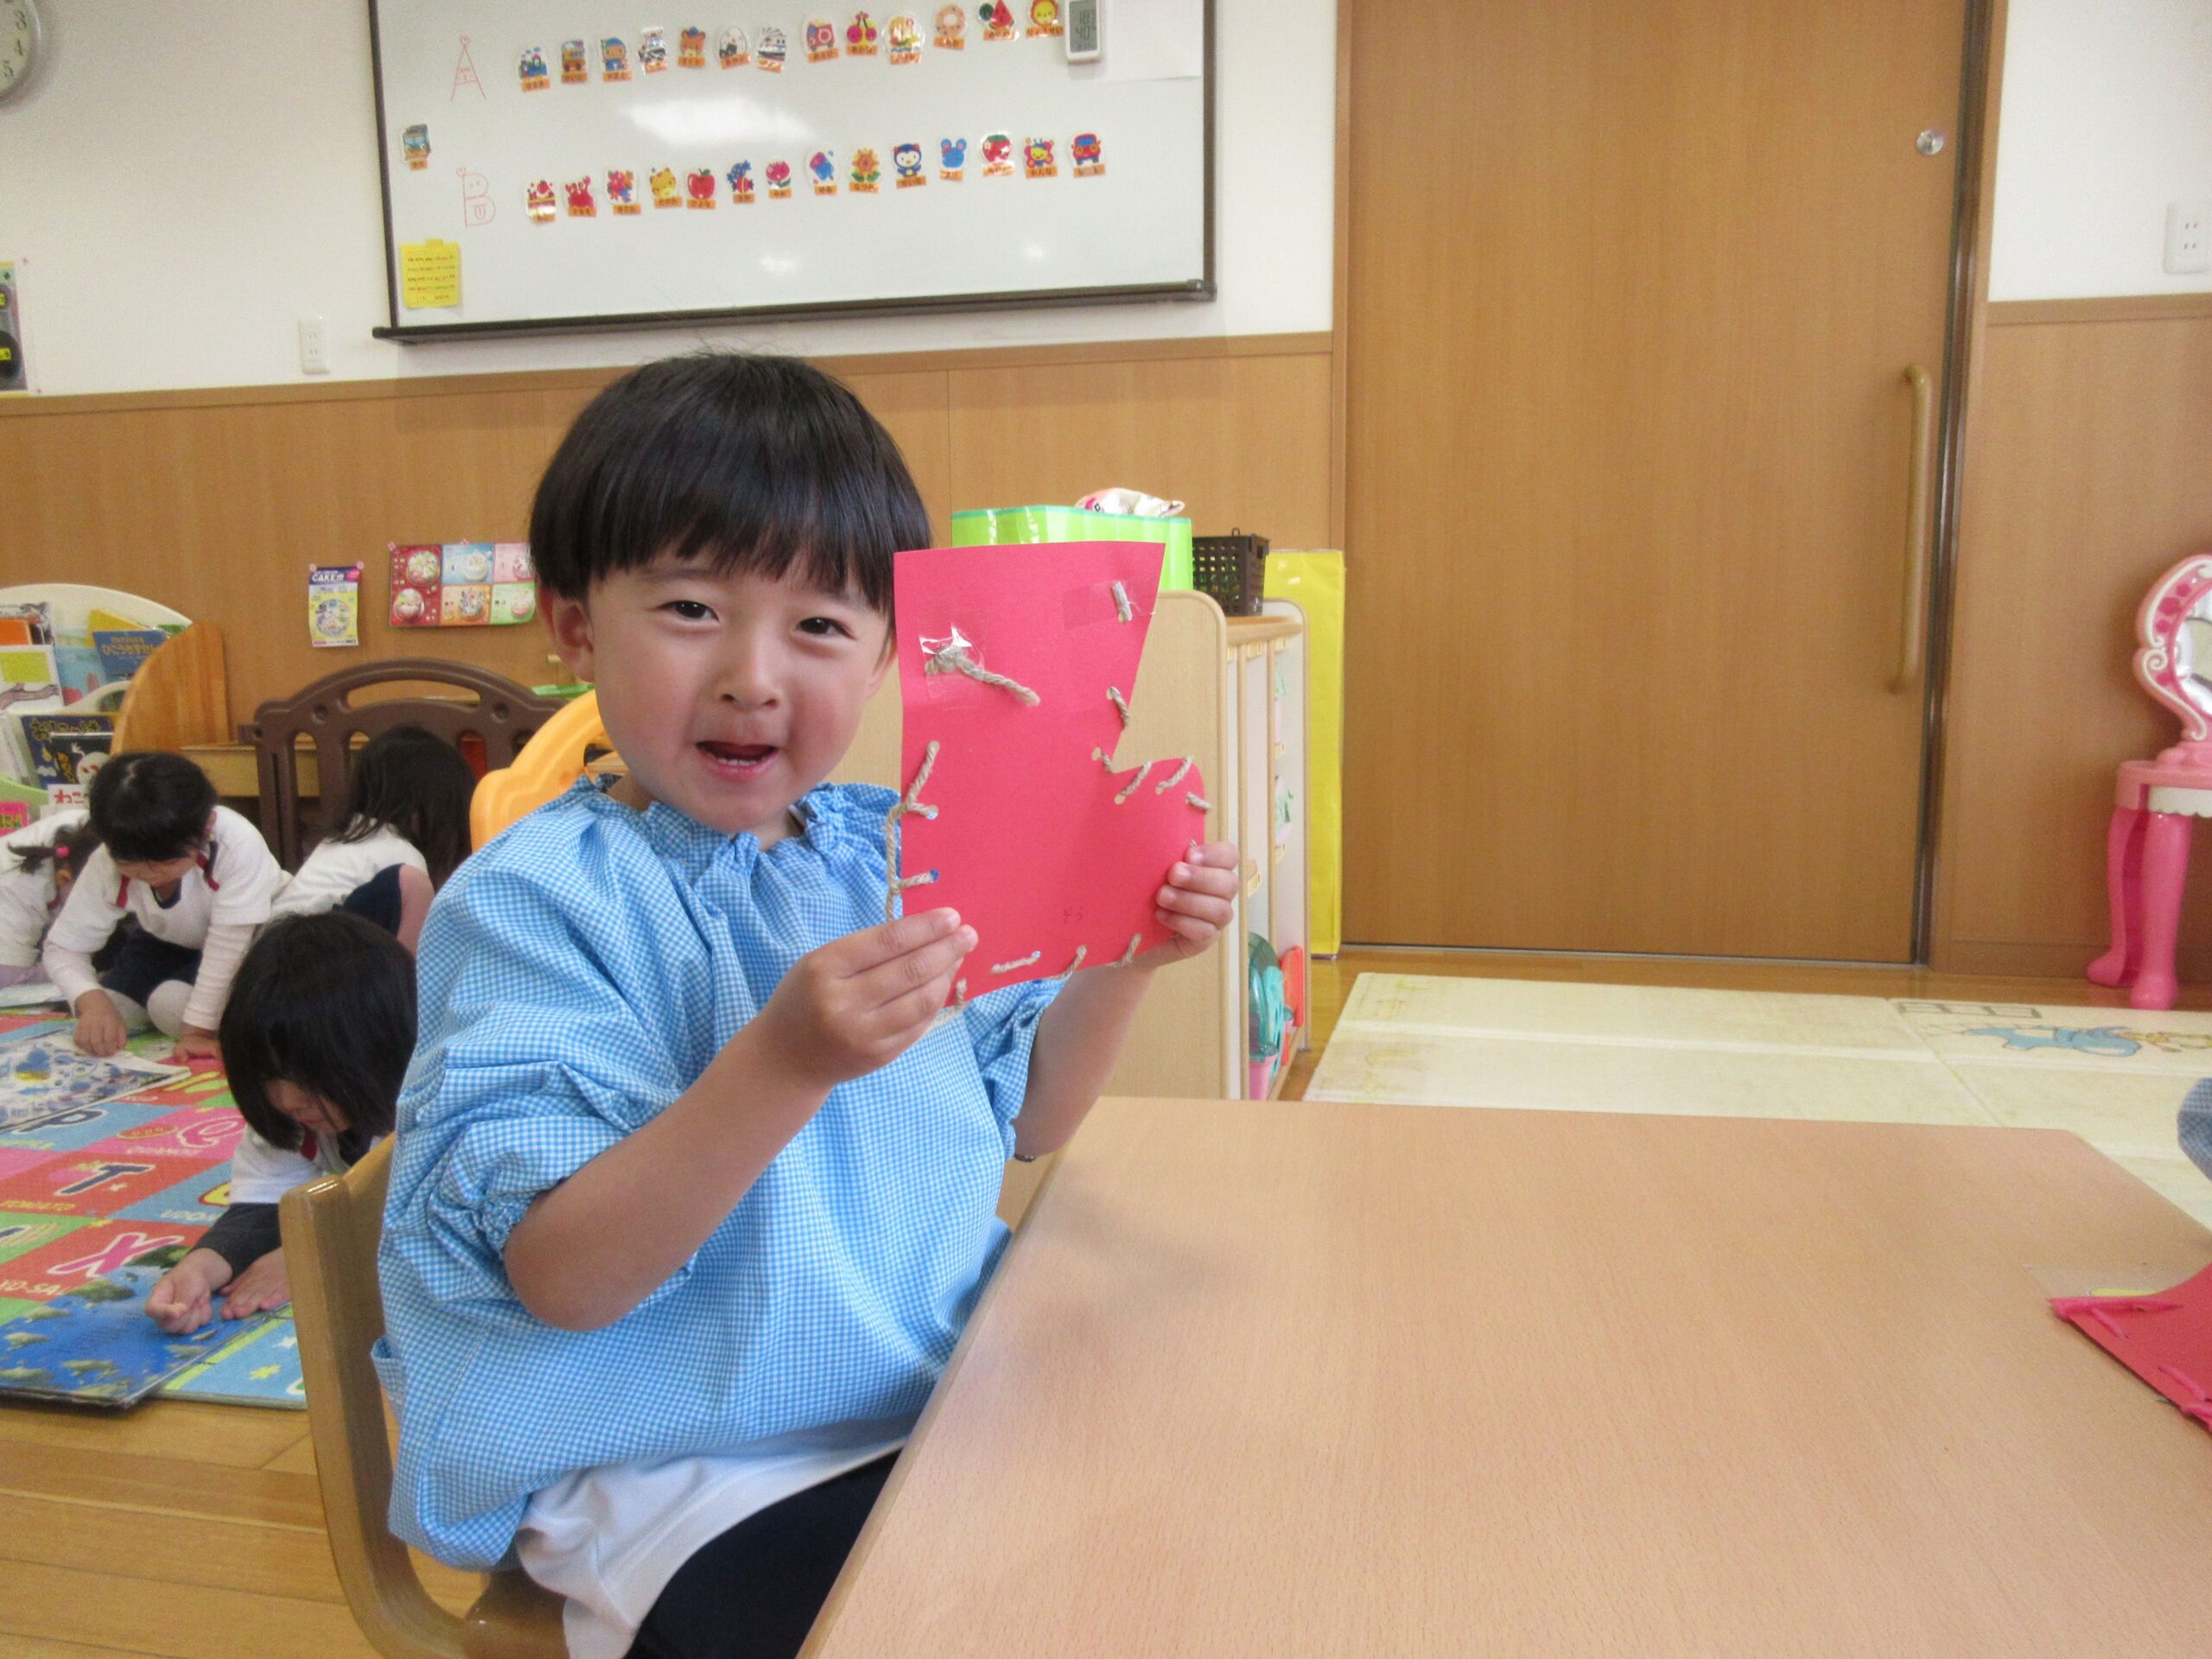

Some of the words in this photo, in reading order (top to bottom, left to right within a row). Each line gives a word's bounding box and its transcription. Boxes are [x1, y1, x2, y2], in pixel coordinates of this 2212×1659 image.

[450, 34, 487, 102] A
[456, 167, 496, 228] B
[54, 1162, 156, 1196] T
[47, 1231, 185, 1278] X
